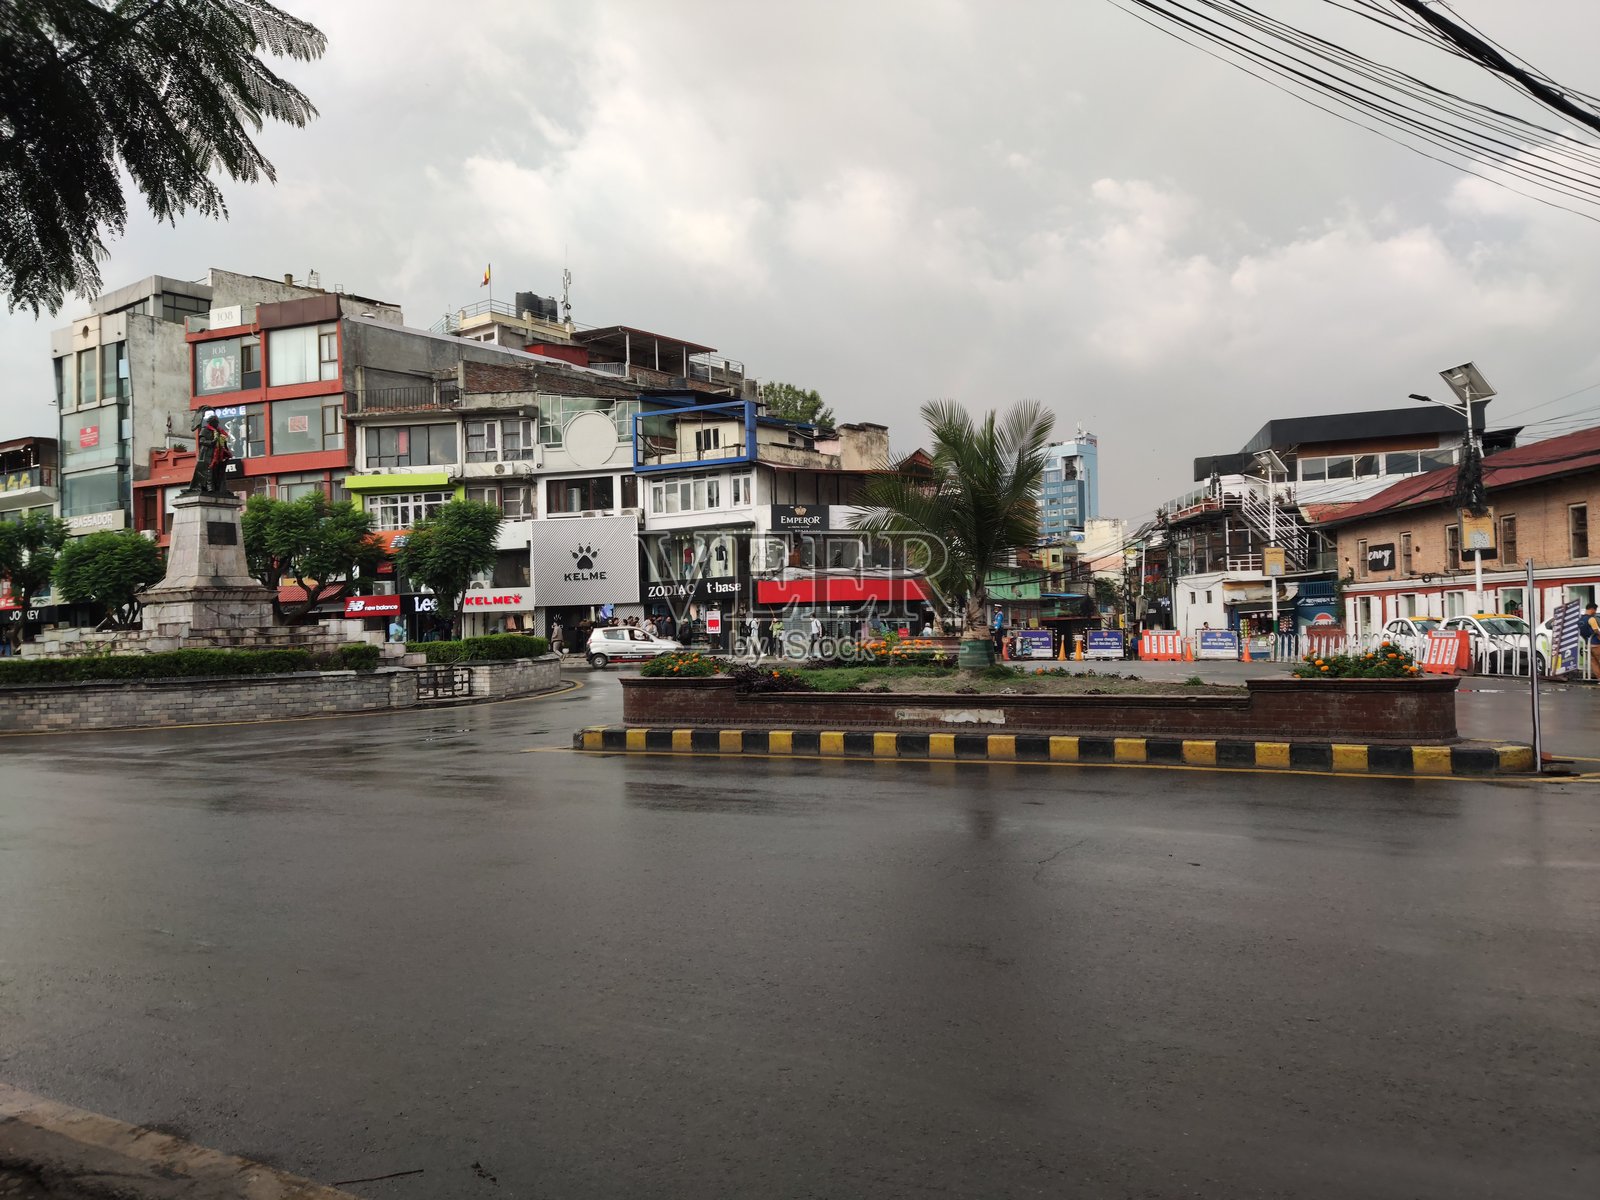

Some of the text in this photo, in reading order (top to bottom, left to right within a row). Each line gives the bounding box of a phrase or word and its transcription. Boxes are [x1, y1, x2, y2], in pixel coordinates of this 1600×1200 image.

[564, 571, 607, 582] KELME
[706, 582, 742, 594] t-base
[465, 595, 513, 605] KELME
